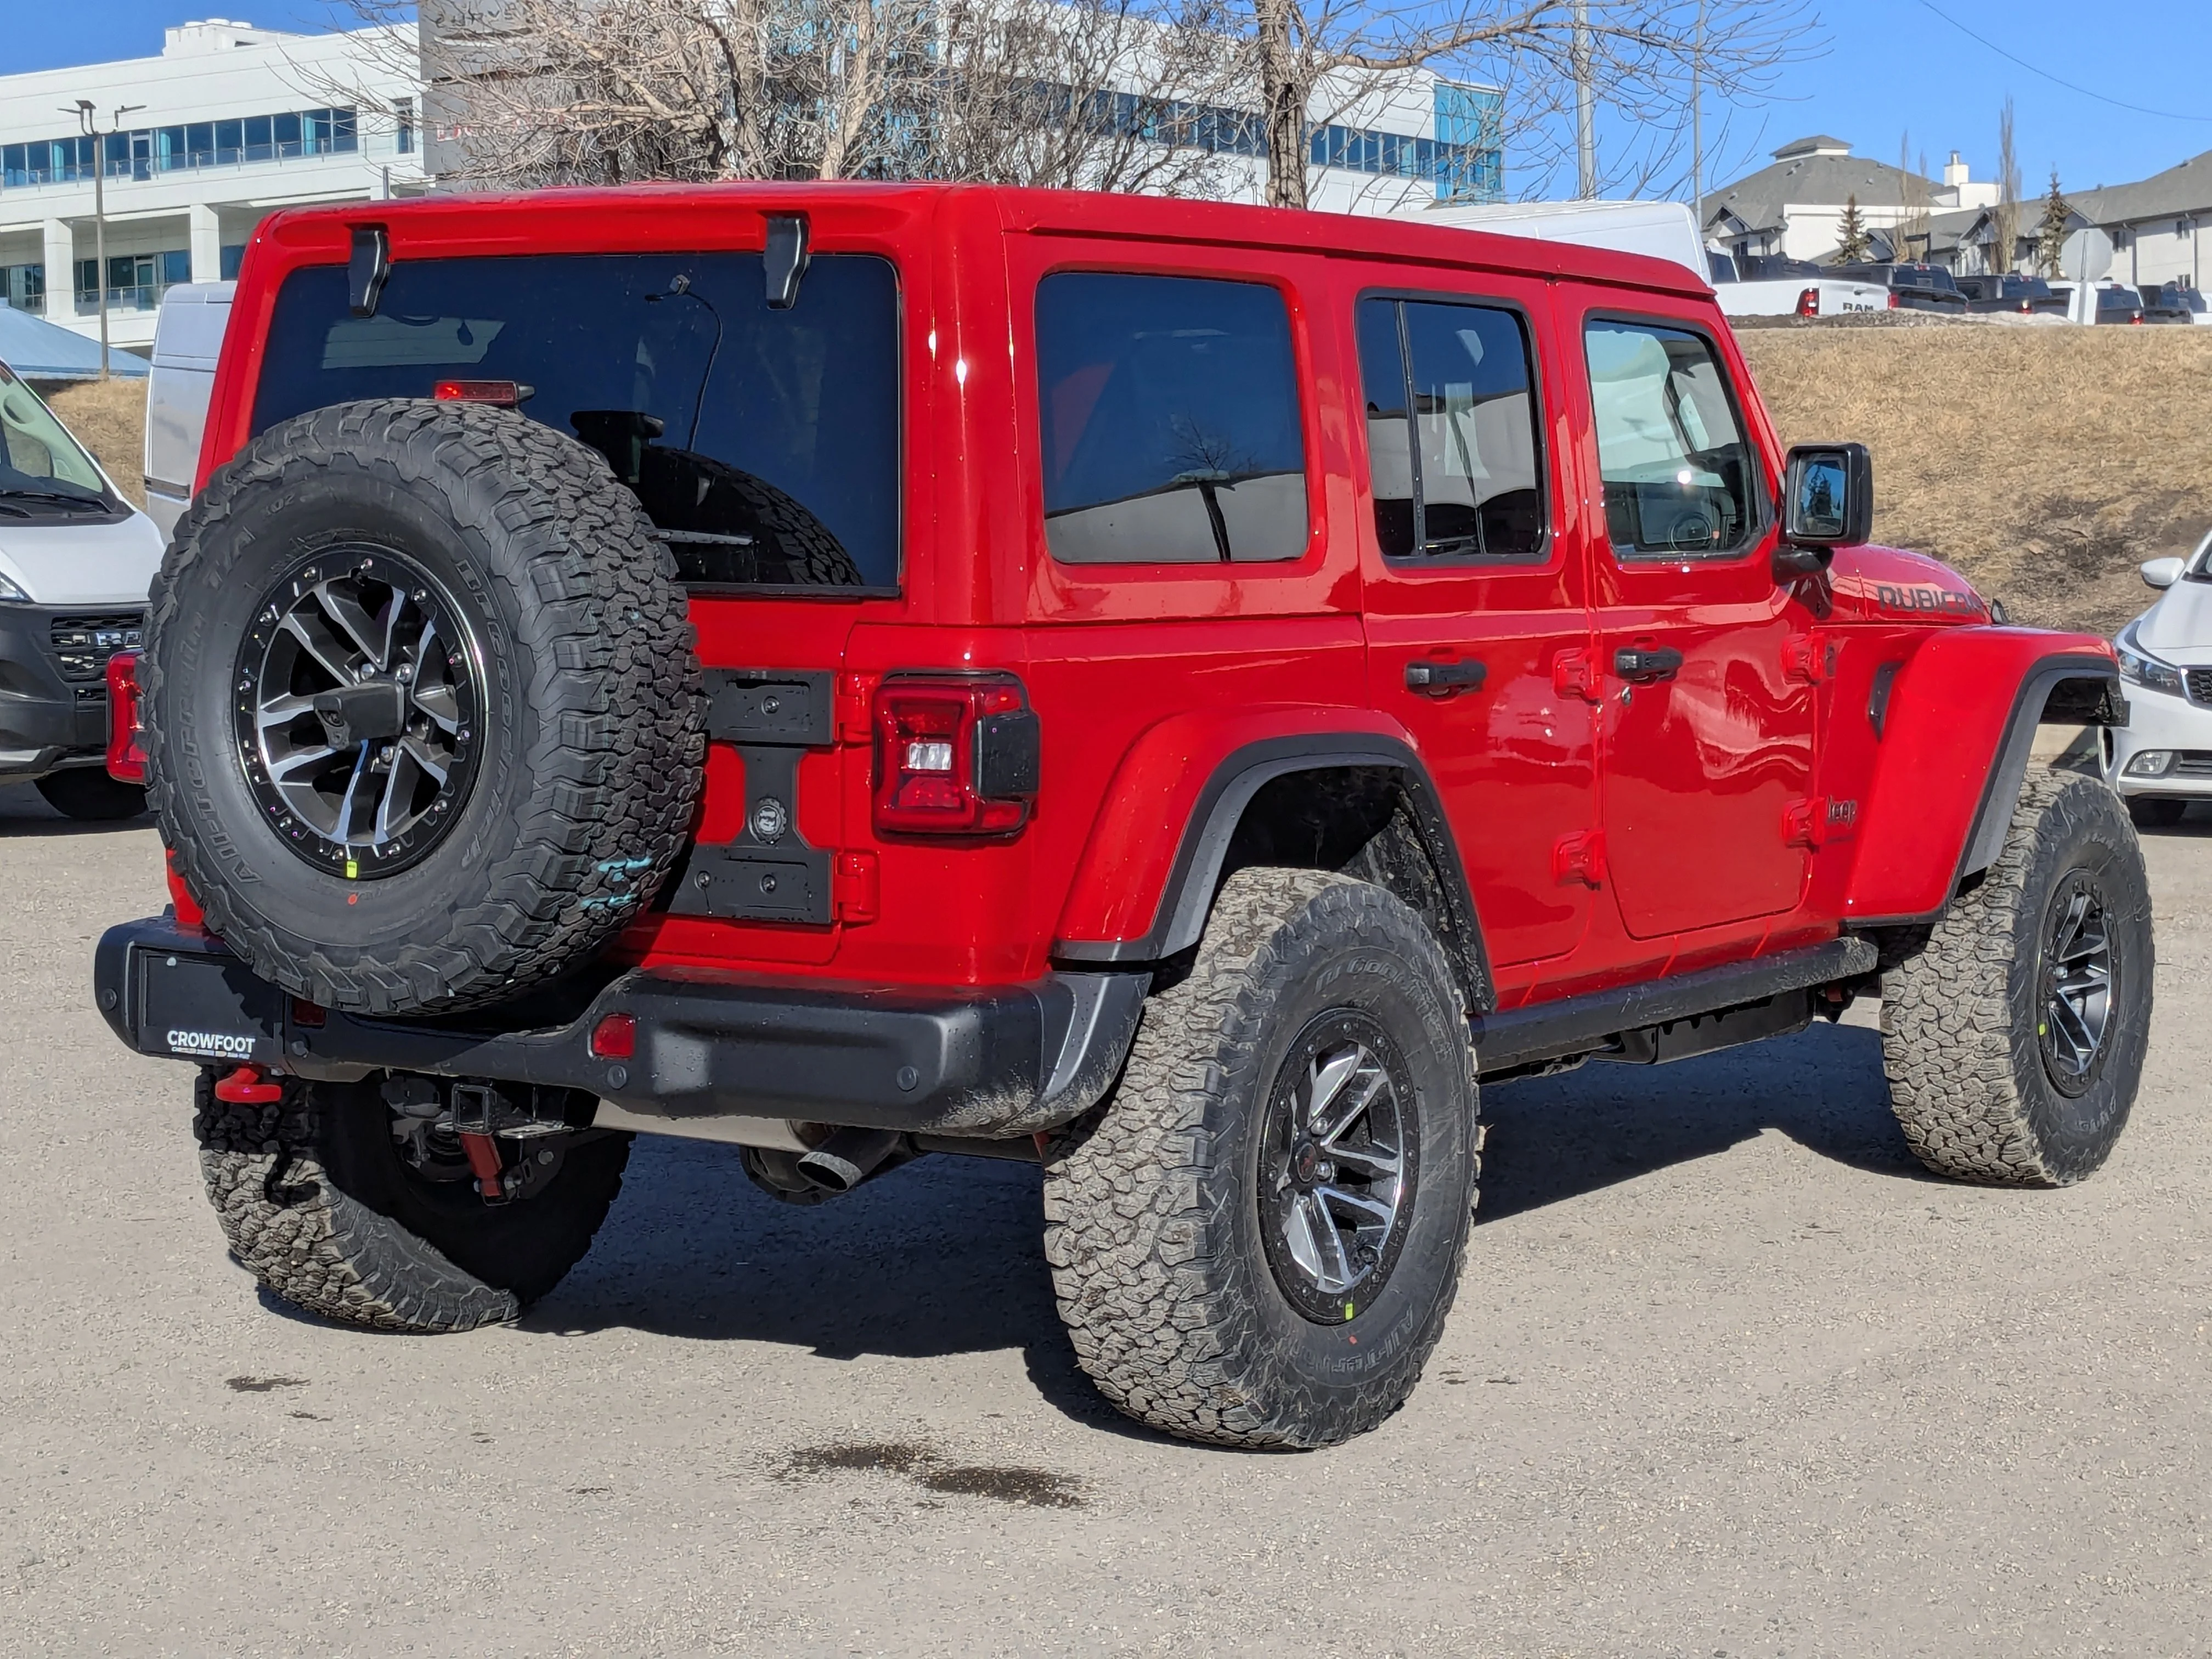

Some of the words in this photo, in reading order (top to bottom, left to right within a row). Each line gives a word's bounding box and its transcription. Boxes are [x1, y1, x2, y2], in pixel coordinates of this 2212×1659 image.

[1842, 302, 1874, 312] RAM
[1827, 794, 1858, 830] Jeep
[166, 1029, 257, 1053] CROWFOOT
